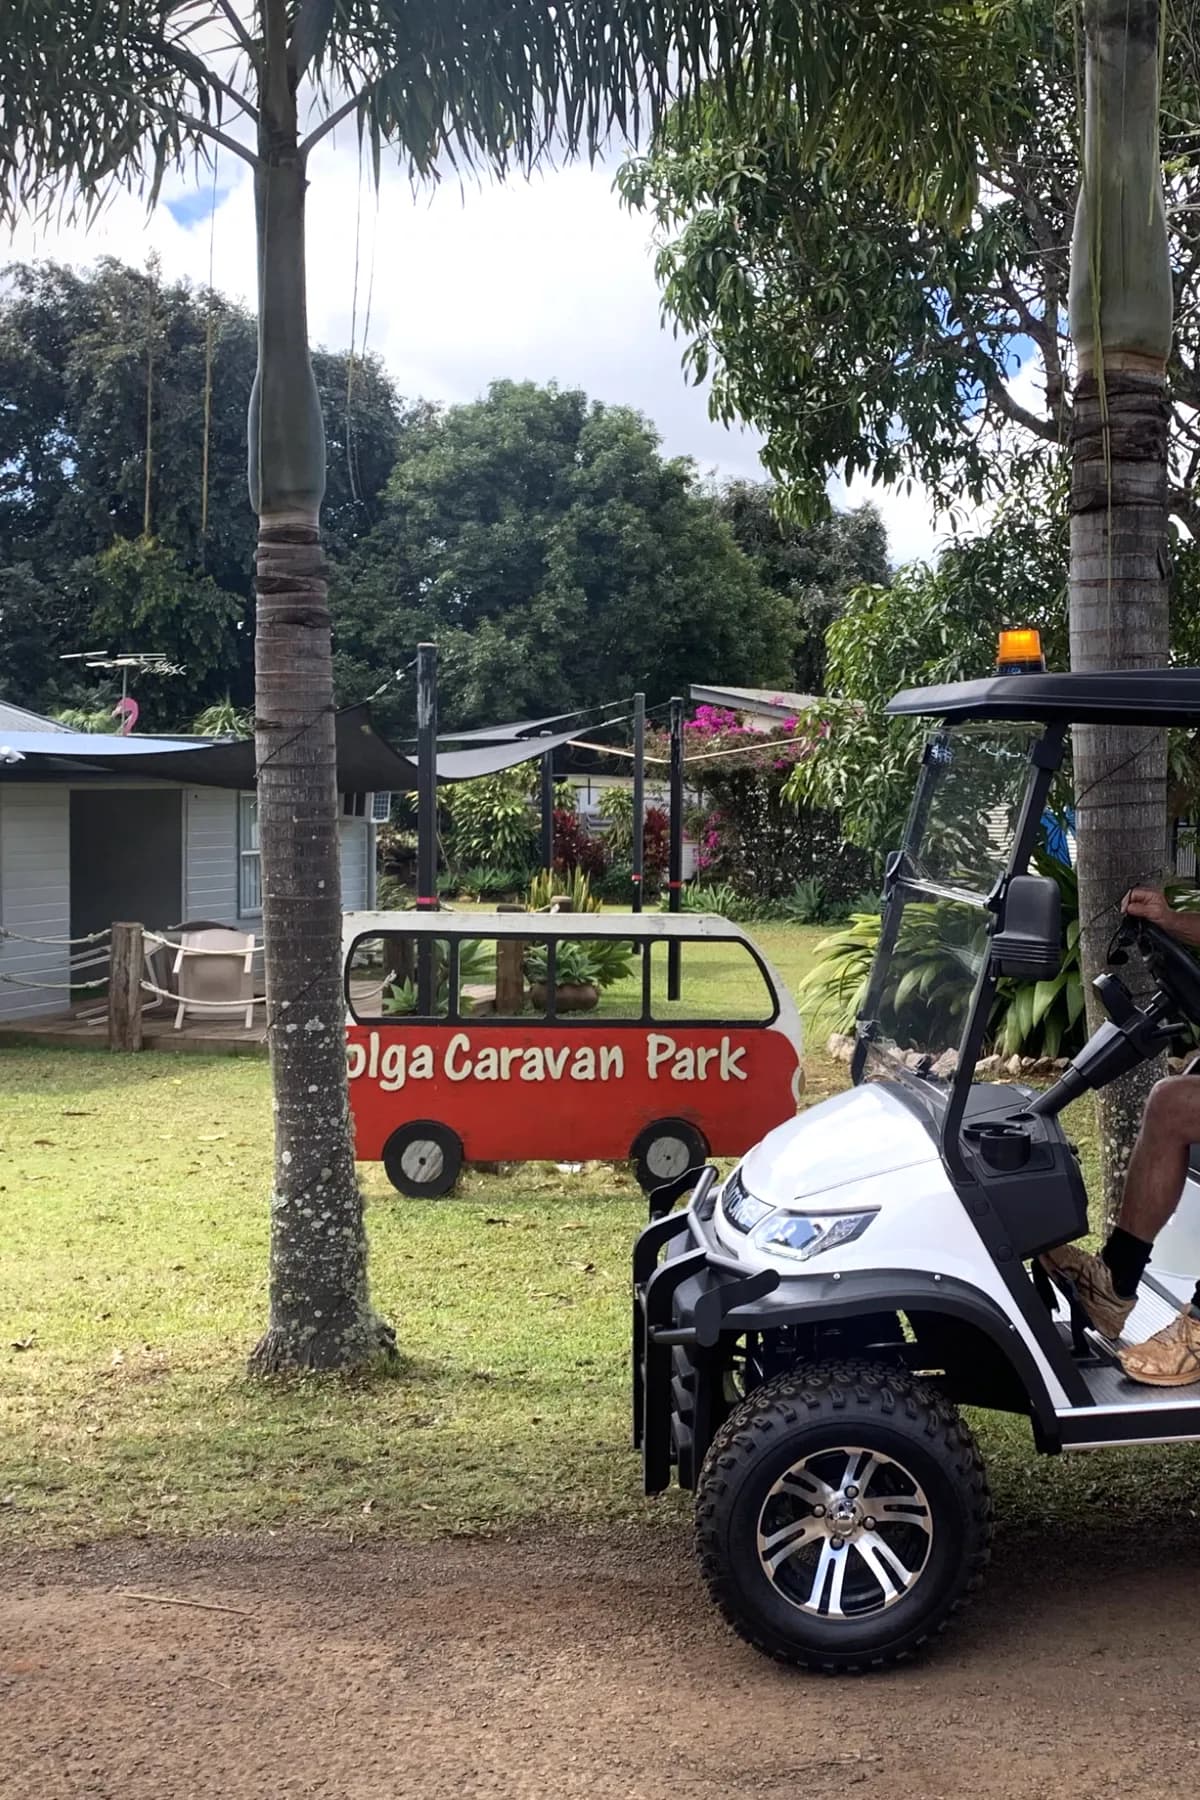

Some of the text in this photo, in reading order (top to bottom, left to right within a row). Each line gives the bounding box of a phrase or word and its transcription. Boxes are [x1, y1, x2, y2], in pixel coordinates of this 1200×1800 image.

[346, 1031, 748, 1092] olga Caravan Park
